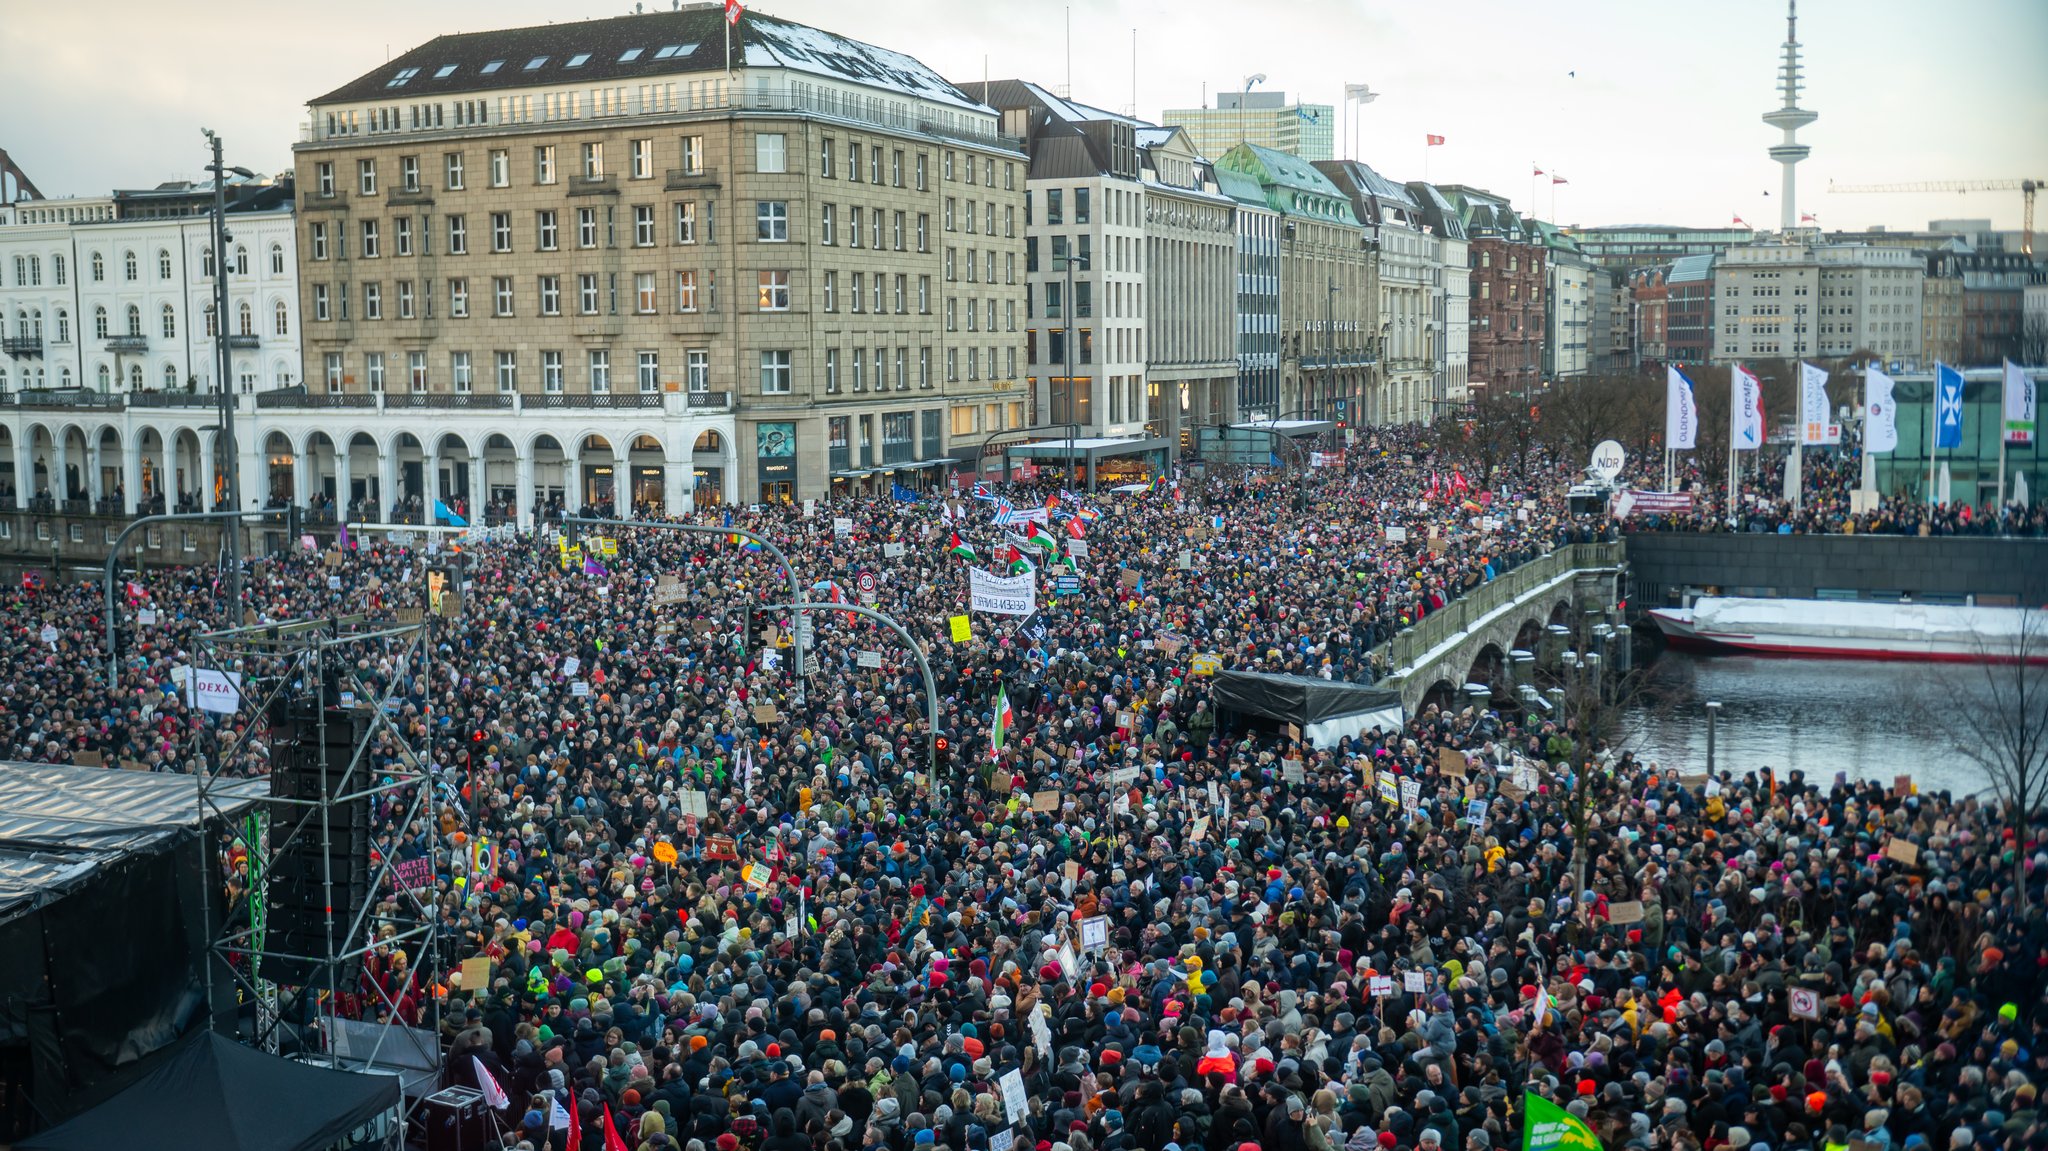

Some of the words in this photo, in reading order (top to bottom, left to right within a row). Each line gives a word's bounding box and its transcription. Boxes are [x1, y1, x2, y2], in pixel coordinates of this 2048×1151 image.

[1337, 400, 1345, 410] U
[1337, 411, 1345, 421] S
[1597, 457, 1620, 468] NDR
[862, 577, 872, 587] 30
